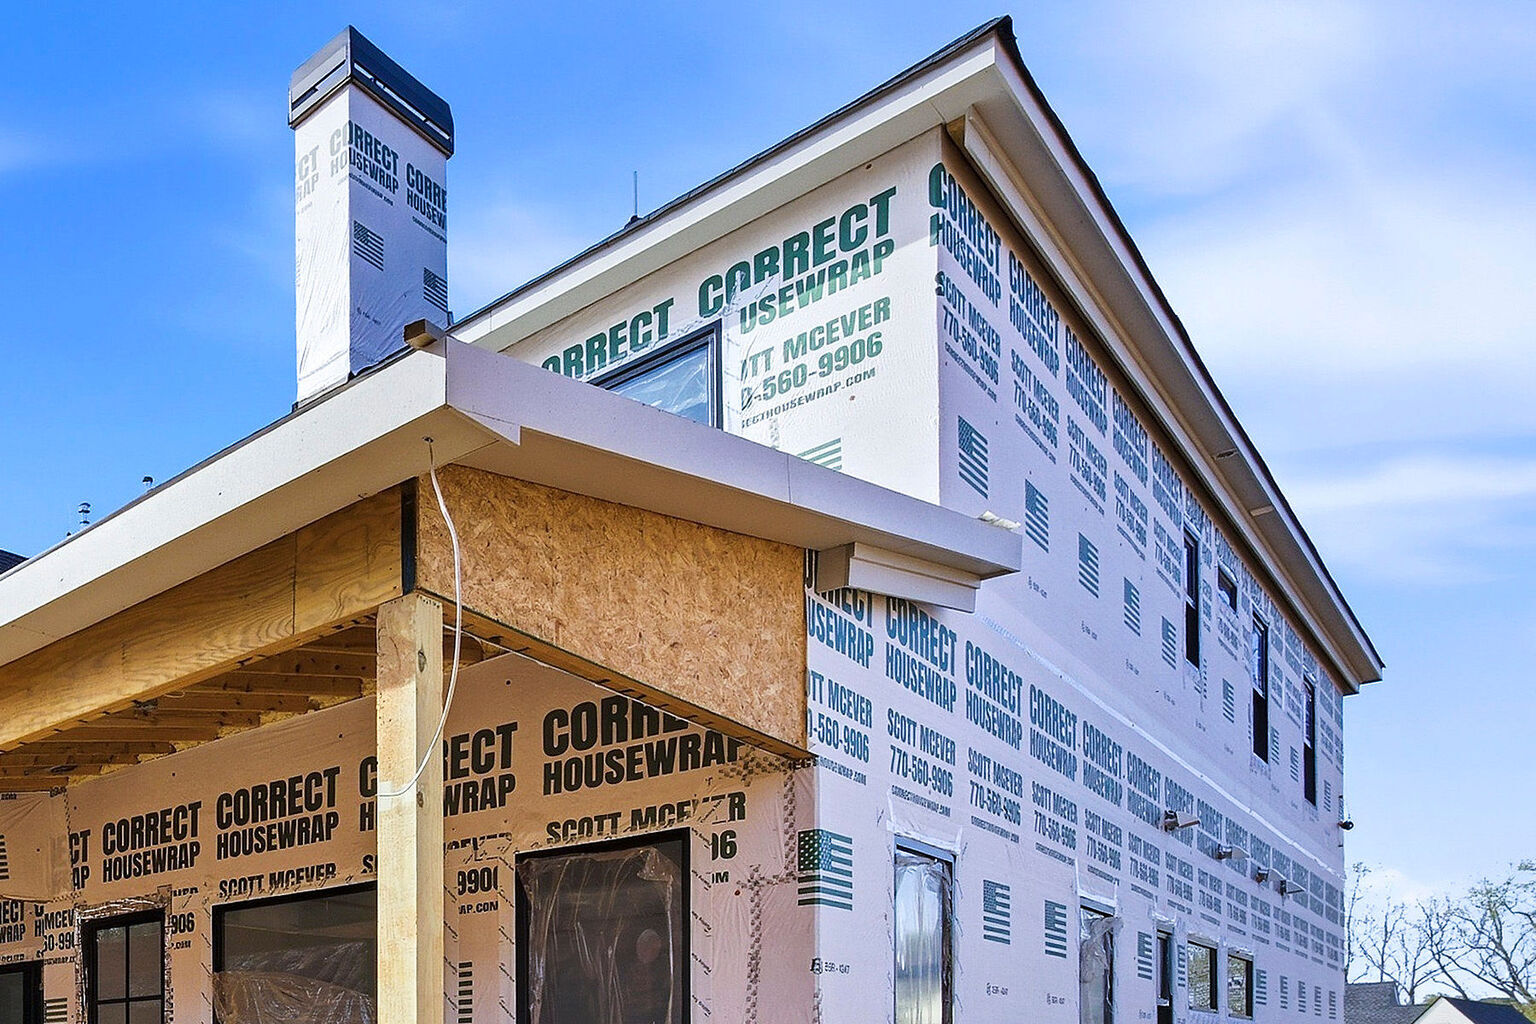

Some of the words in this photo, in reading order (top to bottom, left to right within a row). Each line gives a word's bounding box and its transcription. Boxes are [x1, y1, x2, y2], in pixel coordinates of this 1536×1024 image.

[329, 120, 400, 176] CORRECT
[330, 147, 399, 195] HOUSEWRAP
[929, 162, 1002, 276] CORRECT
[699, 186, 896, 318] CORRECT
[929, 212, 1002, 308] HOUSEWRAP
[783, 297, 891, 359] MCEVER
[935, 270, 965, 320] SCOTT
[968, 302, 1001, 358] MCEVER
[1009, 250, 1060, 350] CORRECT
[1009, 294, 1060, 379] HOUSEWRAP
[1065, 325, 1108, 411] CORRECT
[886, 596, 957, 677] CORRECT
[828, 679, 873, 729] MCEVER
[886, 642, 957, 714] HOUSEWRAP
[965, 640, 1023, 717] CORRECT
[887, 708, 917, 748] SCOTT
[920, 724, 956, 766] MCEVER
[965, 688, 1023, 750] HOUSEWRAP
[1029, 684, 1078, 751] CORRECT
[890, 745, 953, 798] 770-560-9906
[967, 747, 991, 780] SCOTT
[1029, 727, 1078, 782] HOUSEWRAP
[103, 801, 202, 856] CORRECT
[216, 766, 341, 831] CORRECT
[546, 812, 623, 845] SCOTT
[103, 841, 201, 883] HOUSEWRAP
[216, 811, 340, 860] HOUSEWRAP
